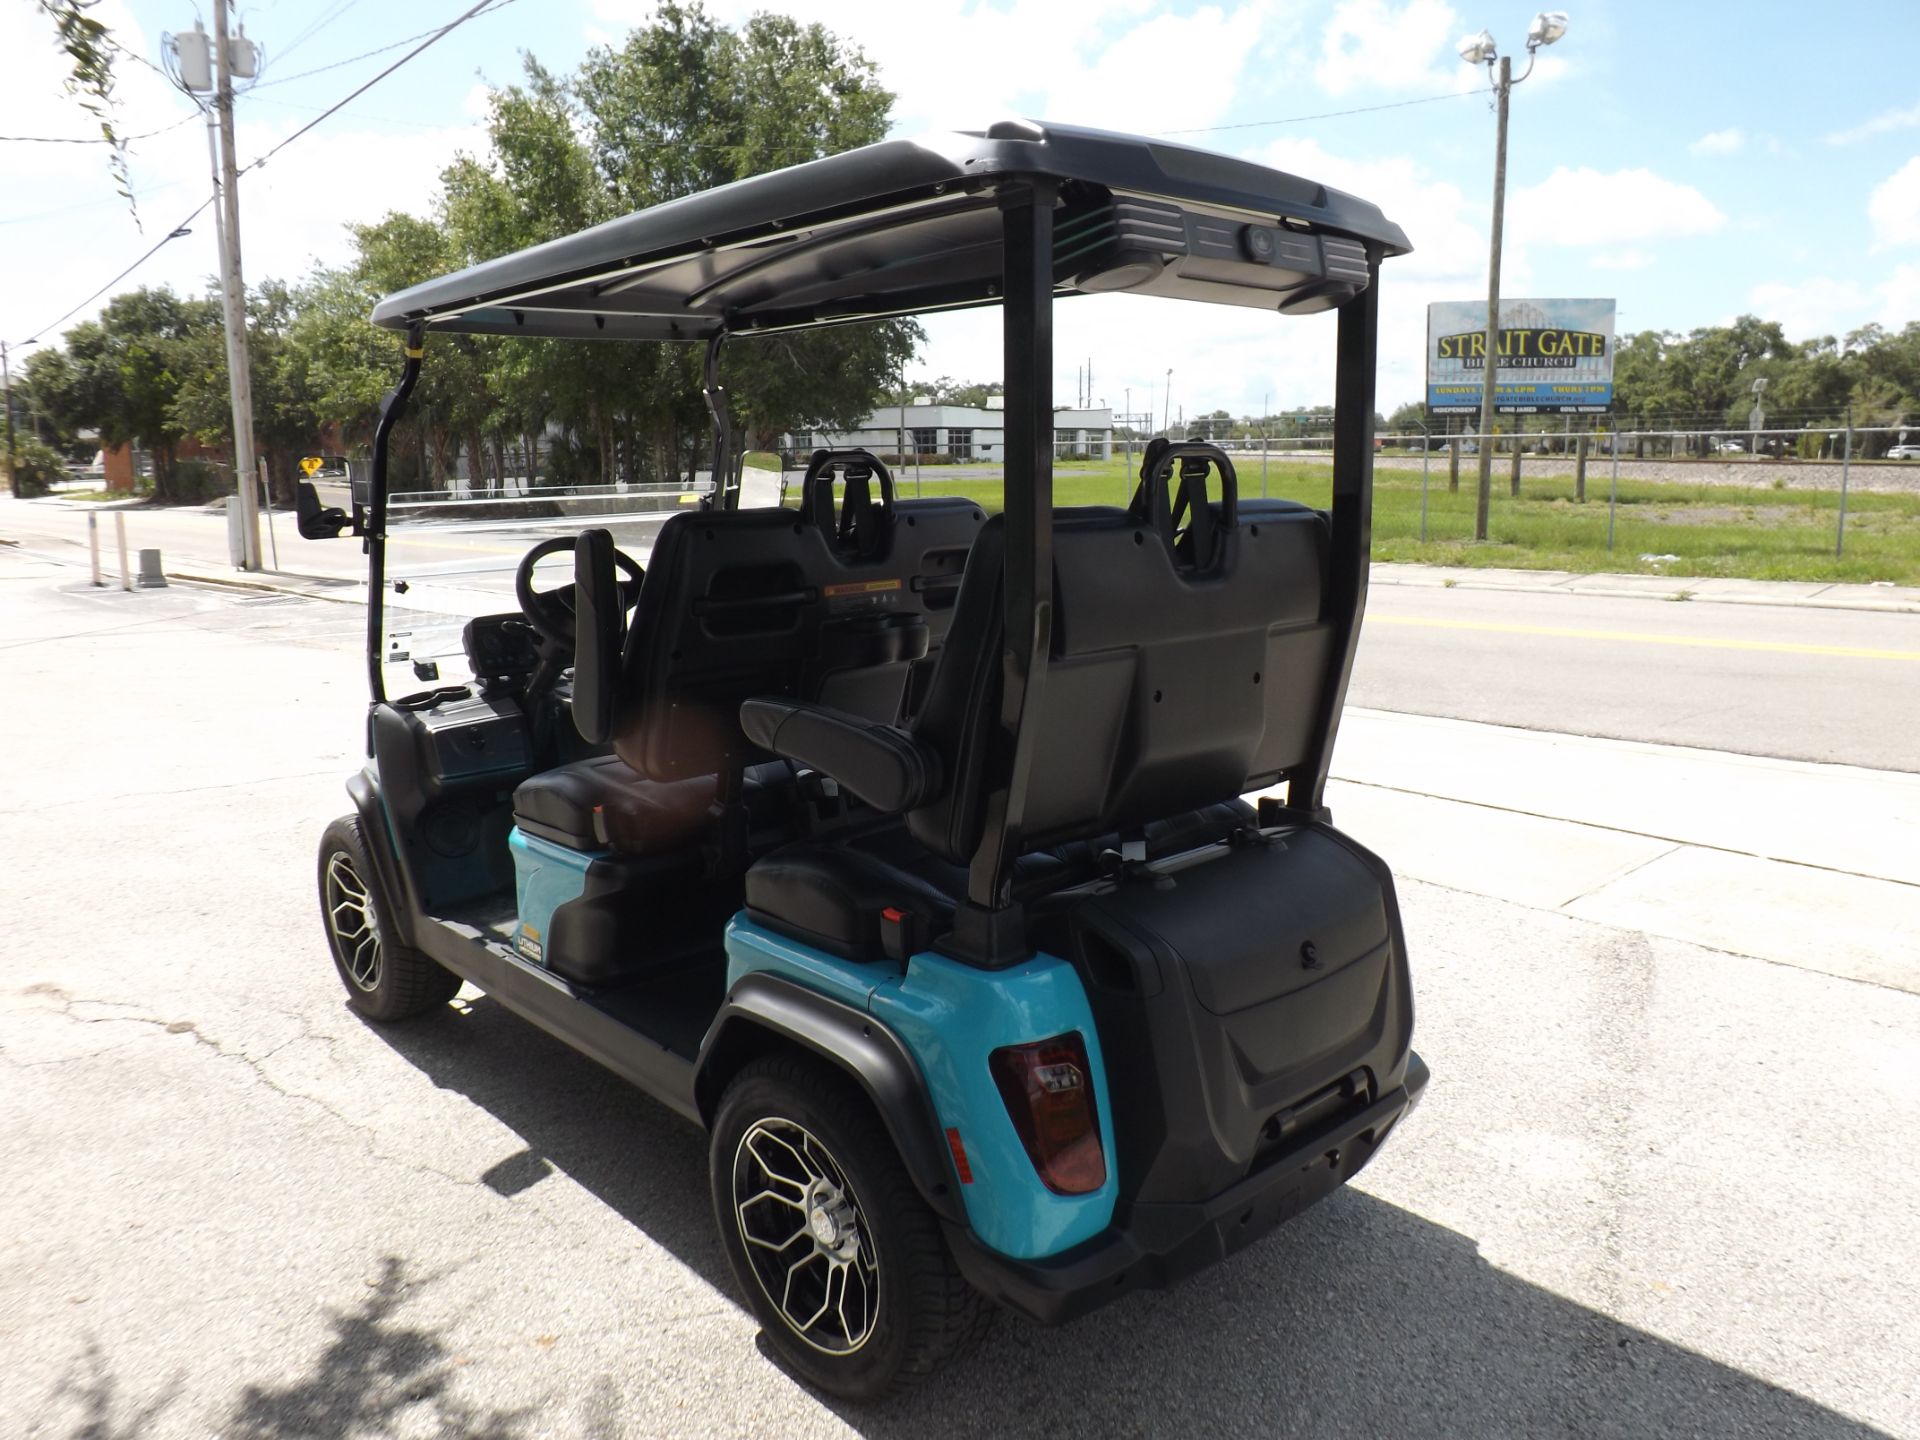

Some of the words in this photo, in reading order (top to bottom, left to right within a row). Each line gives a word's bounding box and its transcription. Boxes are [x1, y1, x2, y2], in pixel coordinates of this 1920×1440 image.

[1537, 330, 1602, 357] GATE
[1511, 357, 1574, 367] CHURCH
[1432, 406, 1477, 414] INDEPENDENT
